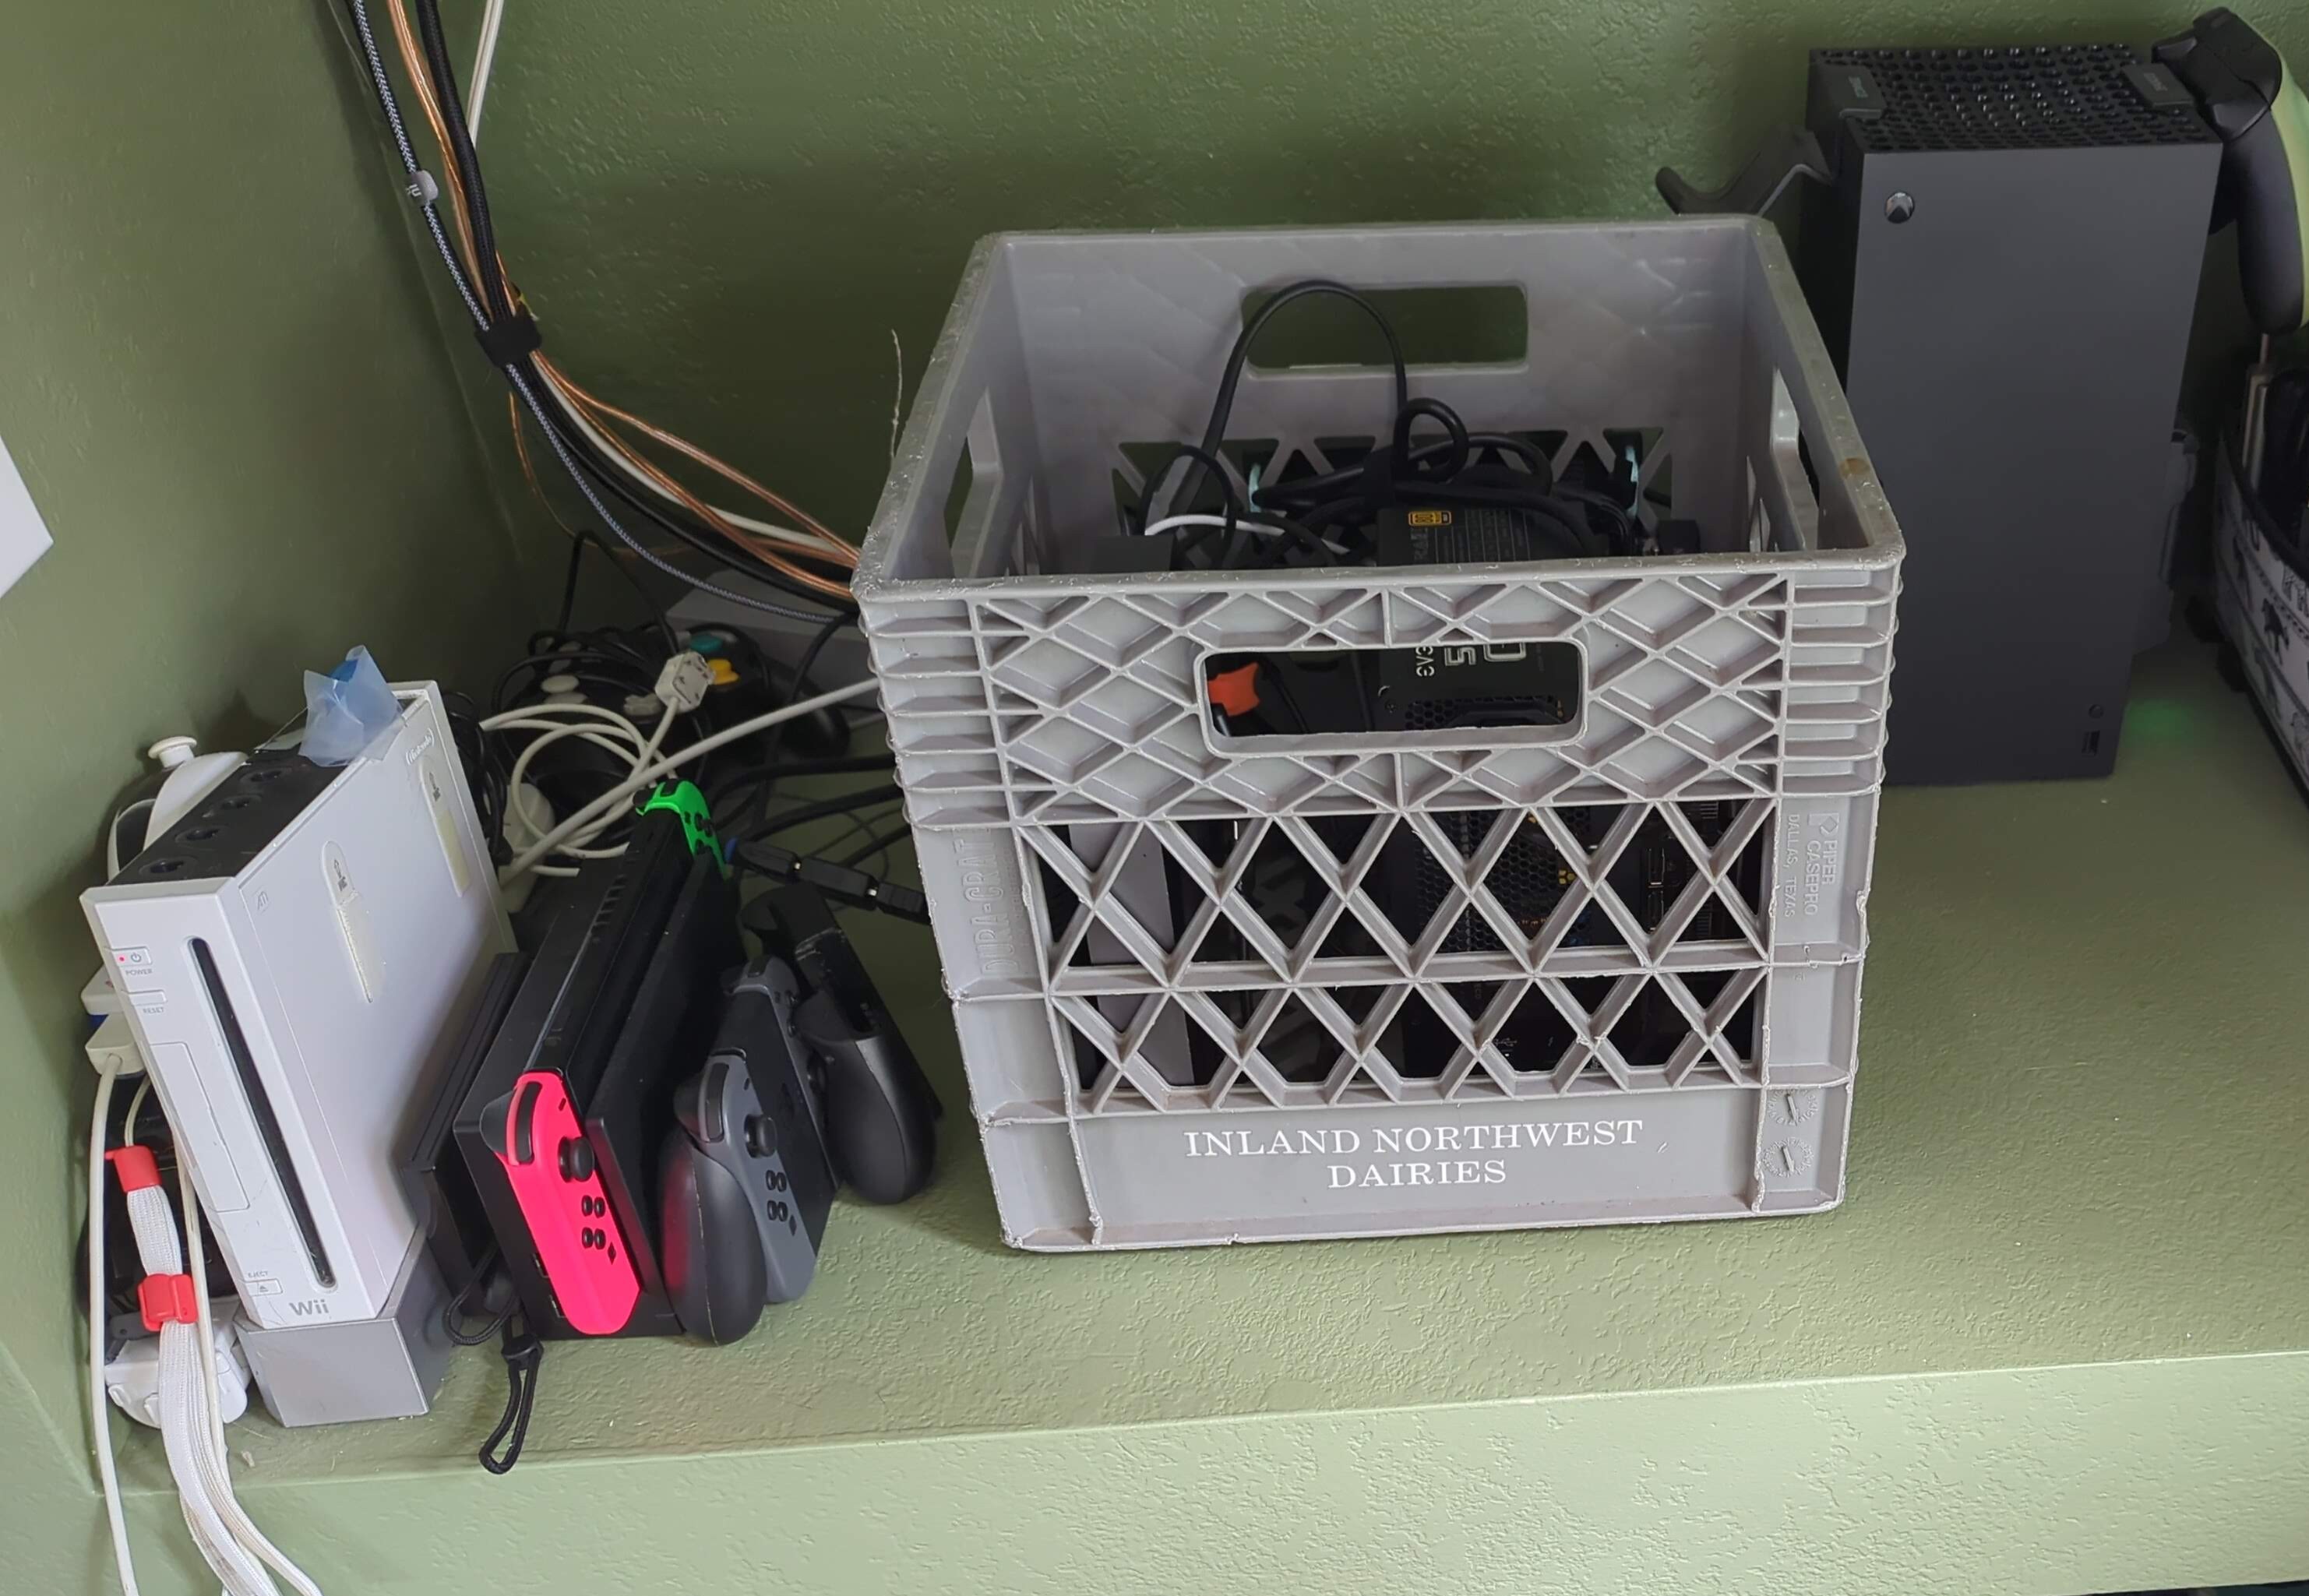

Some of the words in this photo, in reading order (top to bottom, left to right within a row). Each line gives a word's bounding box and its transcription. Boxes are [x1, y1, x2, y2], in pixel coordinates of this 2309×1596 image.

[1803, 840, 1821, 915] CASEPRO
[1821, 840, 1838, 885] PIPER
[1784, 876, 1796, 918] TEXAS
[125, 967, 153, 976] POWER
[1183, 1129, 1361, 1157] INLAND
[1372, 1119, 1643, 1154] NORTHWEST
[1327, 1159, 1507, 1189] DAIRIES
[289, 1298, 330, 1316] Wii
